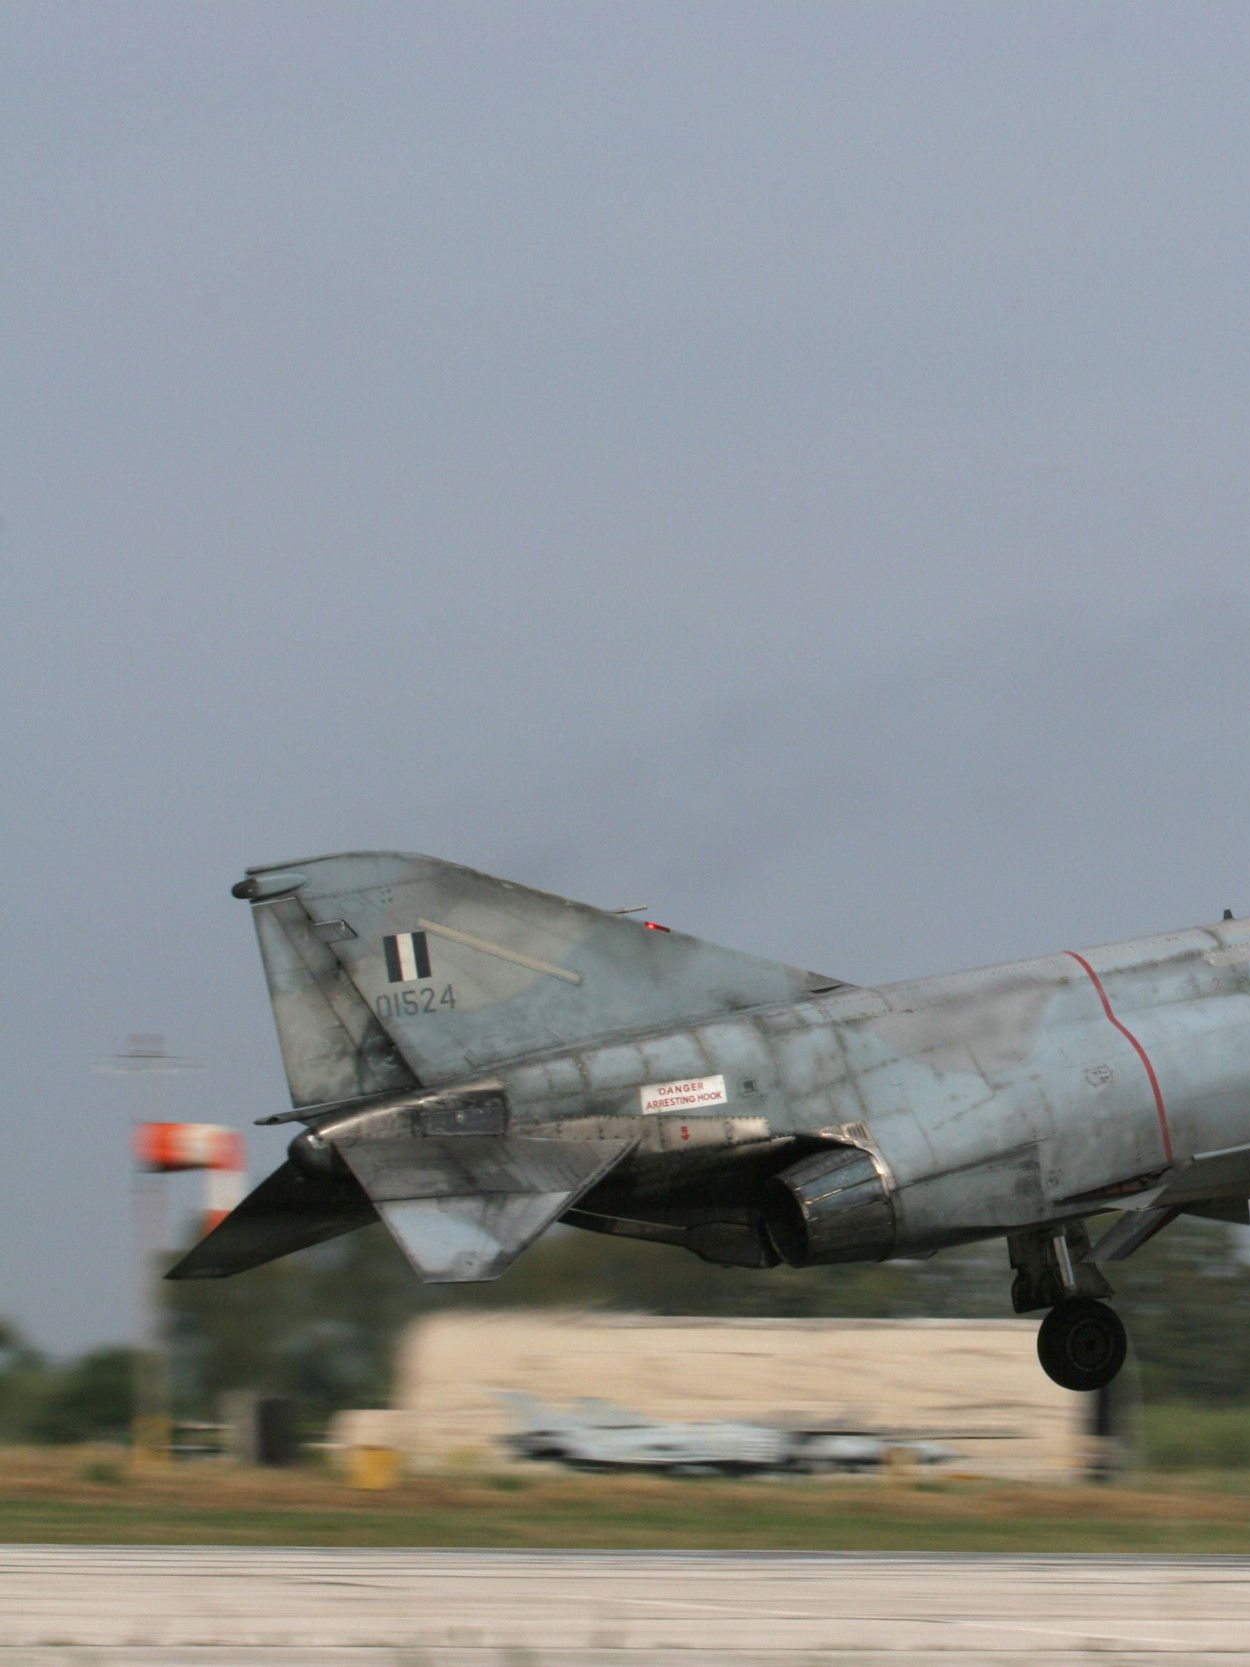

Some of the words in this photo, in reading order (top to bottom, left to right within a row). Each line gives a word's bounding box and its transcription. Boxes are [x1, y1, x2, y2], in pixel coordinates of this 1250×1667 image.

[376, 984, 457, 1020] 01524
[658, 1082, 704, 1096] DANGER
[646, 1095, 696, 1110] ARRESTING
[697, 1091, 723, 1102] HOOK
